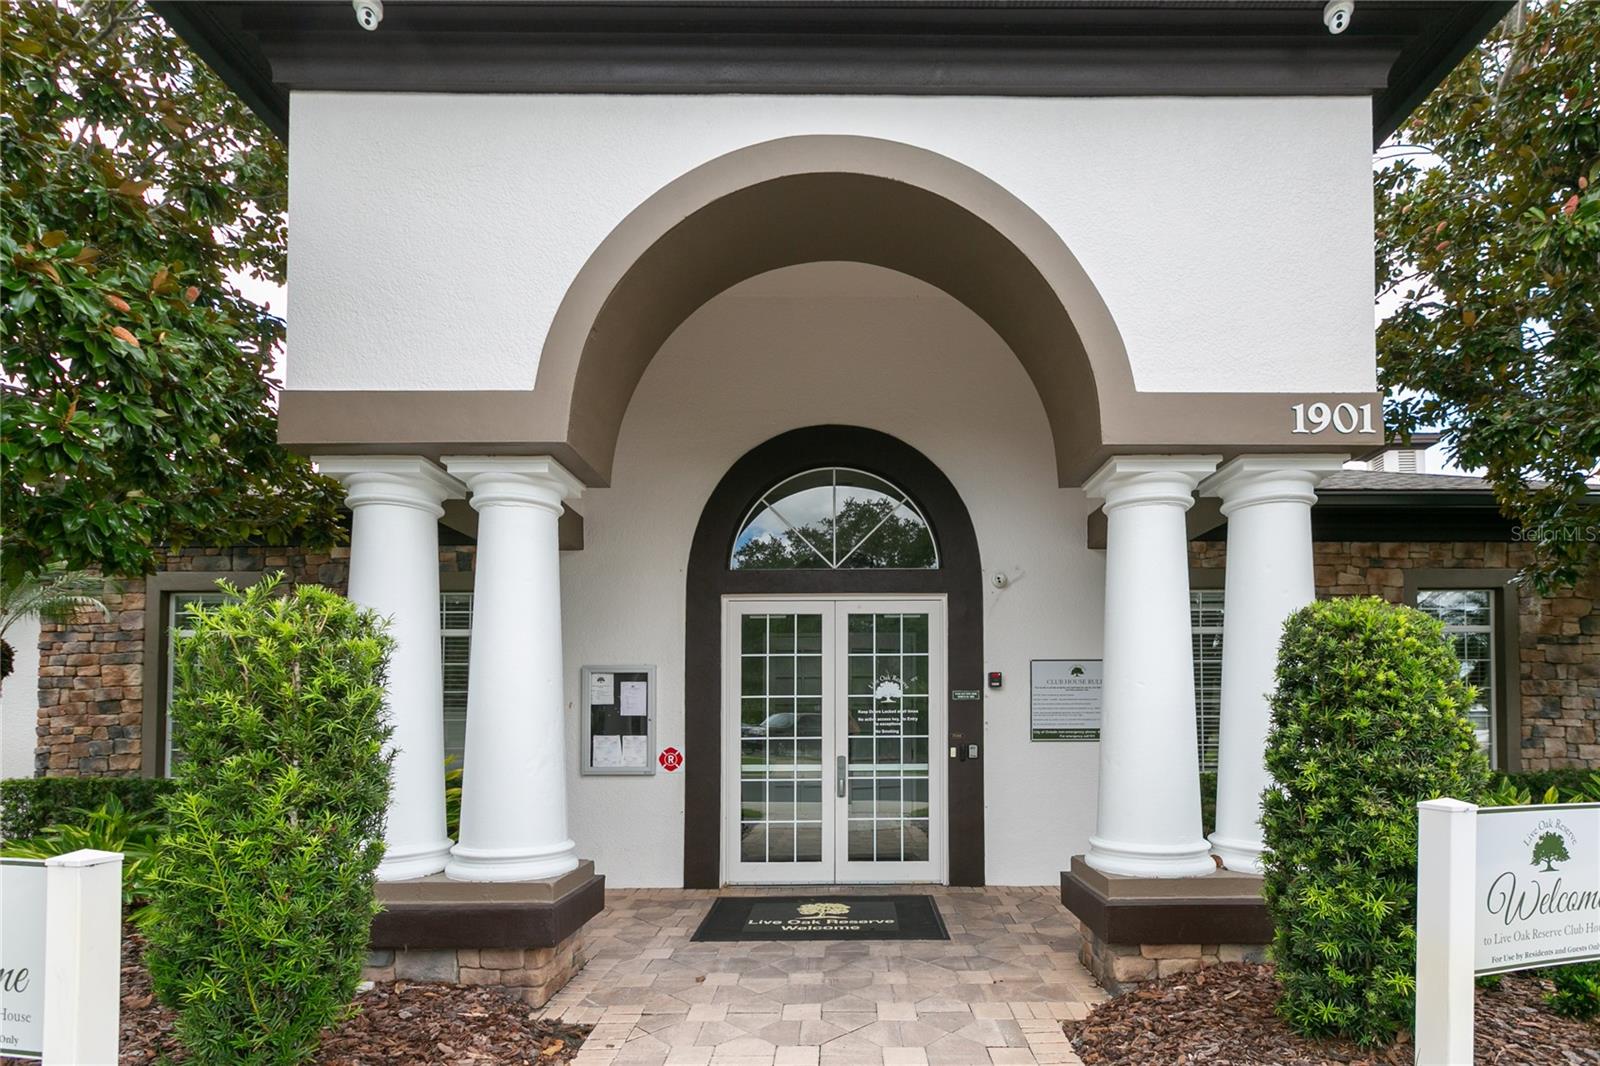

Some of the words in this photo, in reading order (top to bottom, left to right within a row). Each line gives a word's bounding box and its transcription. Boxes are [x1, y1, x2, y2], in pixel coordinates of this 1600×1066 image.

[1291, 402, 1376, 434] 1901
[668, 755, 674, 764] R
[1523, 827, 1539, 847] Live
[1538, 818, 1553, 831] Oak
[1555, 818, 1578, 846] Reserve
[1483, 937, 1492, 946] to
[1494, 933, 1511, 945] Live
[1513, 930, 1531, 942] Oak
[1532, 927, 1562, 940] Reserve
[1564, 923, 1584, 936] Club
[1491, 956, 1503, 964] For
[1503, 954, 1515, 962] Use
[1515, 952, 1524, 962] by
[1524, 949, 1554, 959] Residents
[1554, 946, 1567, 954] and
[1567, 944, 1588, 953] Guests
